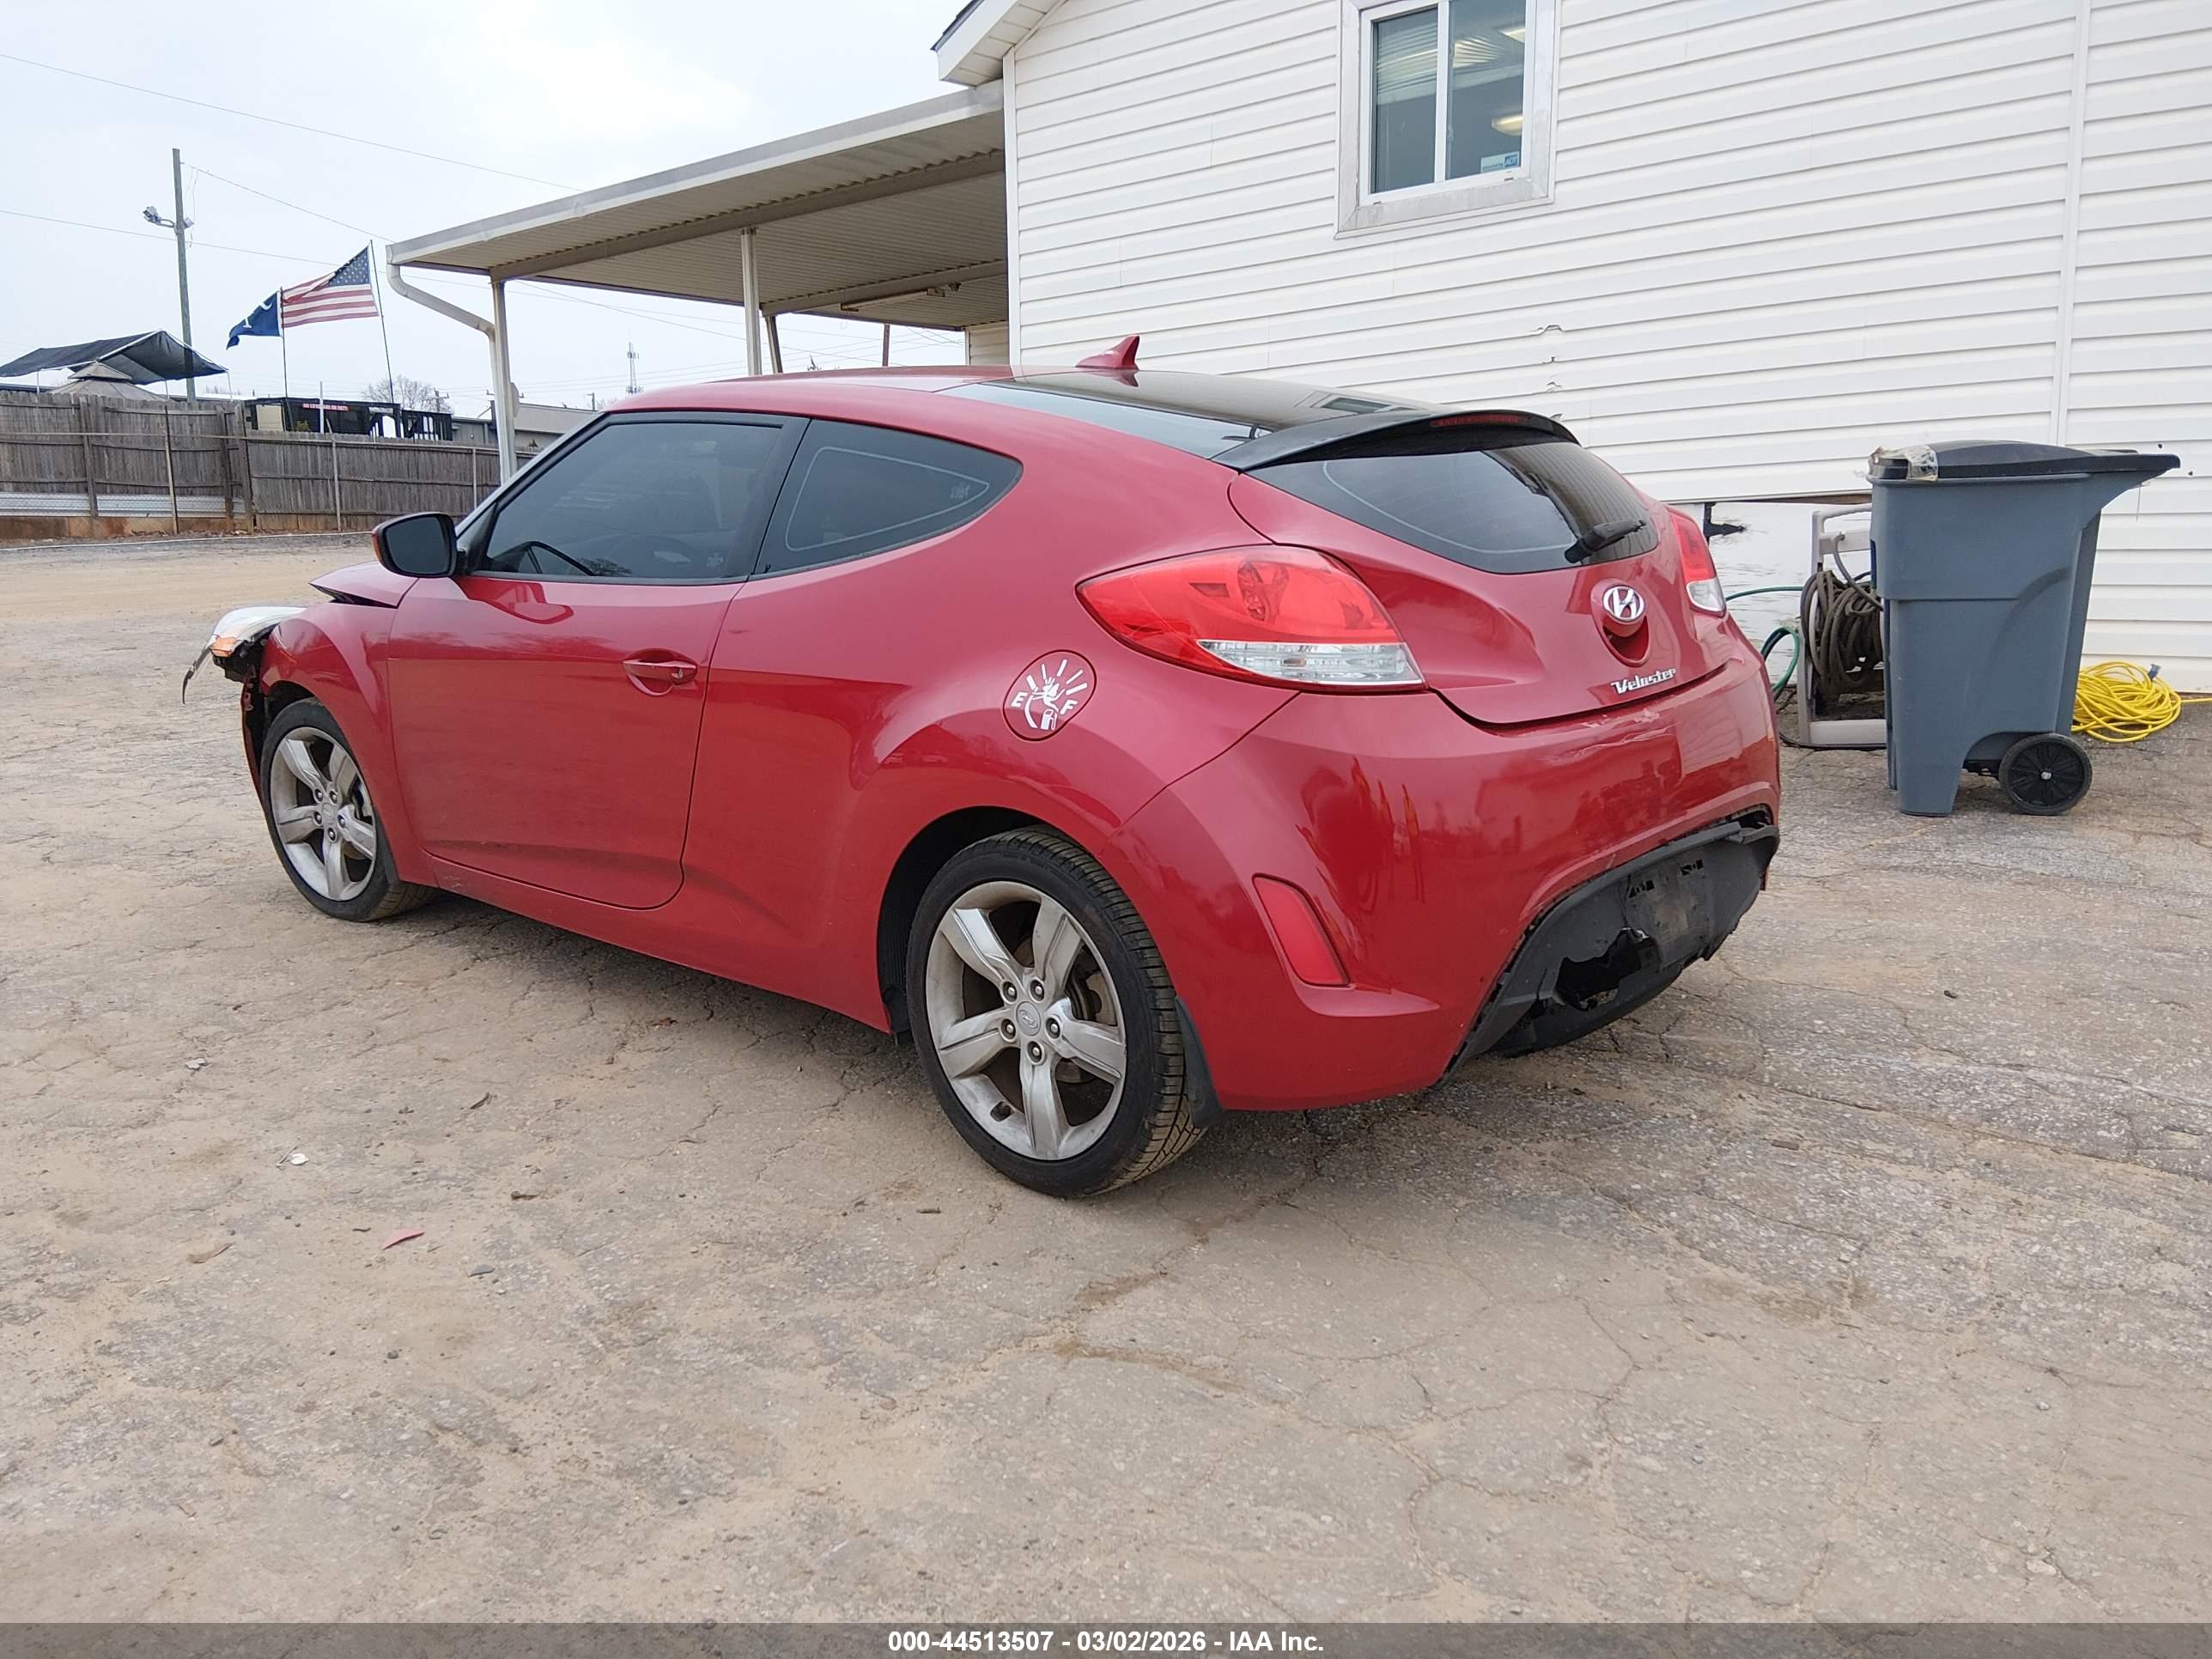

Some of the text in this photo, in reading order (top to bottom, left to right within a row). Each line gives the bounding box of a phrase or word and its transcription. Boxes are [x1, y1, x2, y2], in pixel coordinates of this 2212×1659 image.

[1610, 668, 1676, 694] Veloster
[1012, 691, 1028, 708] E
[1060, 699, 1079, 715] F
